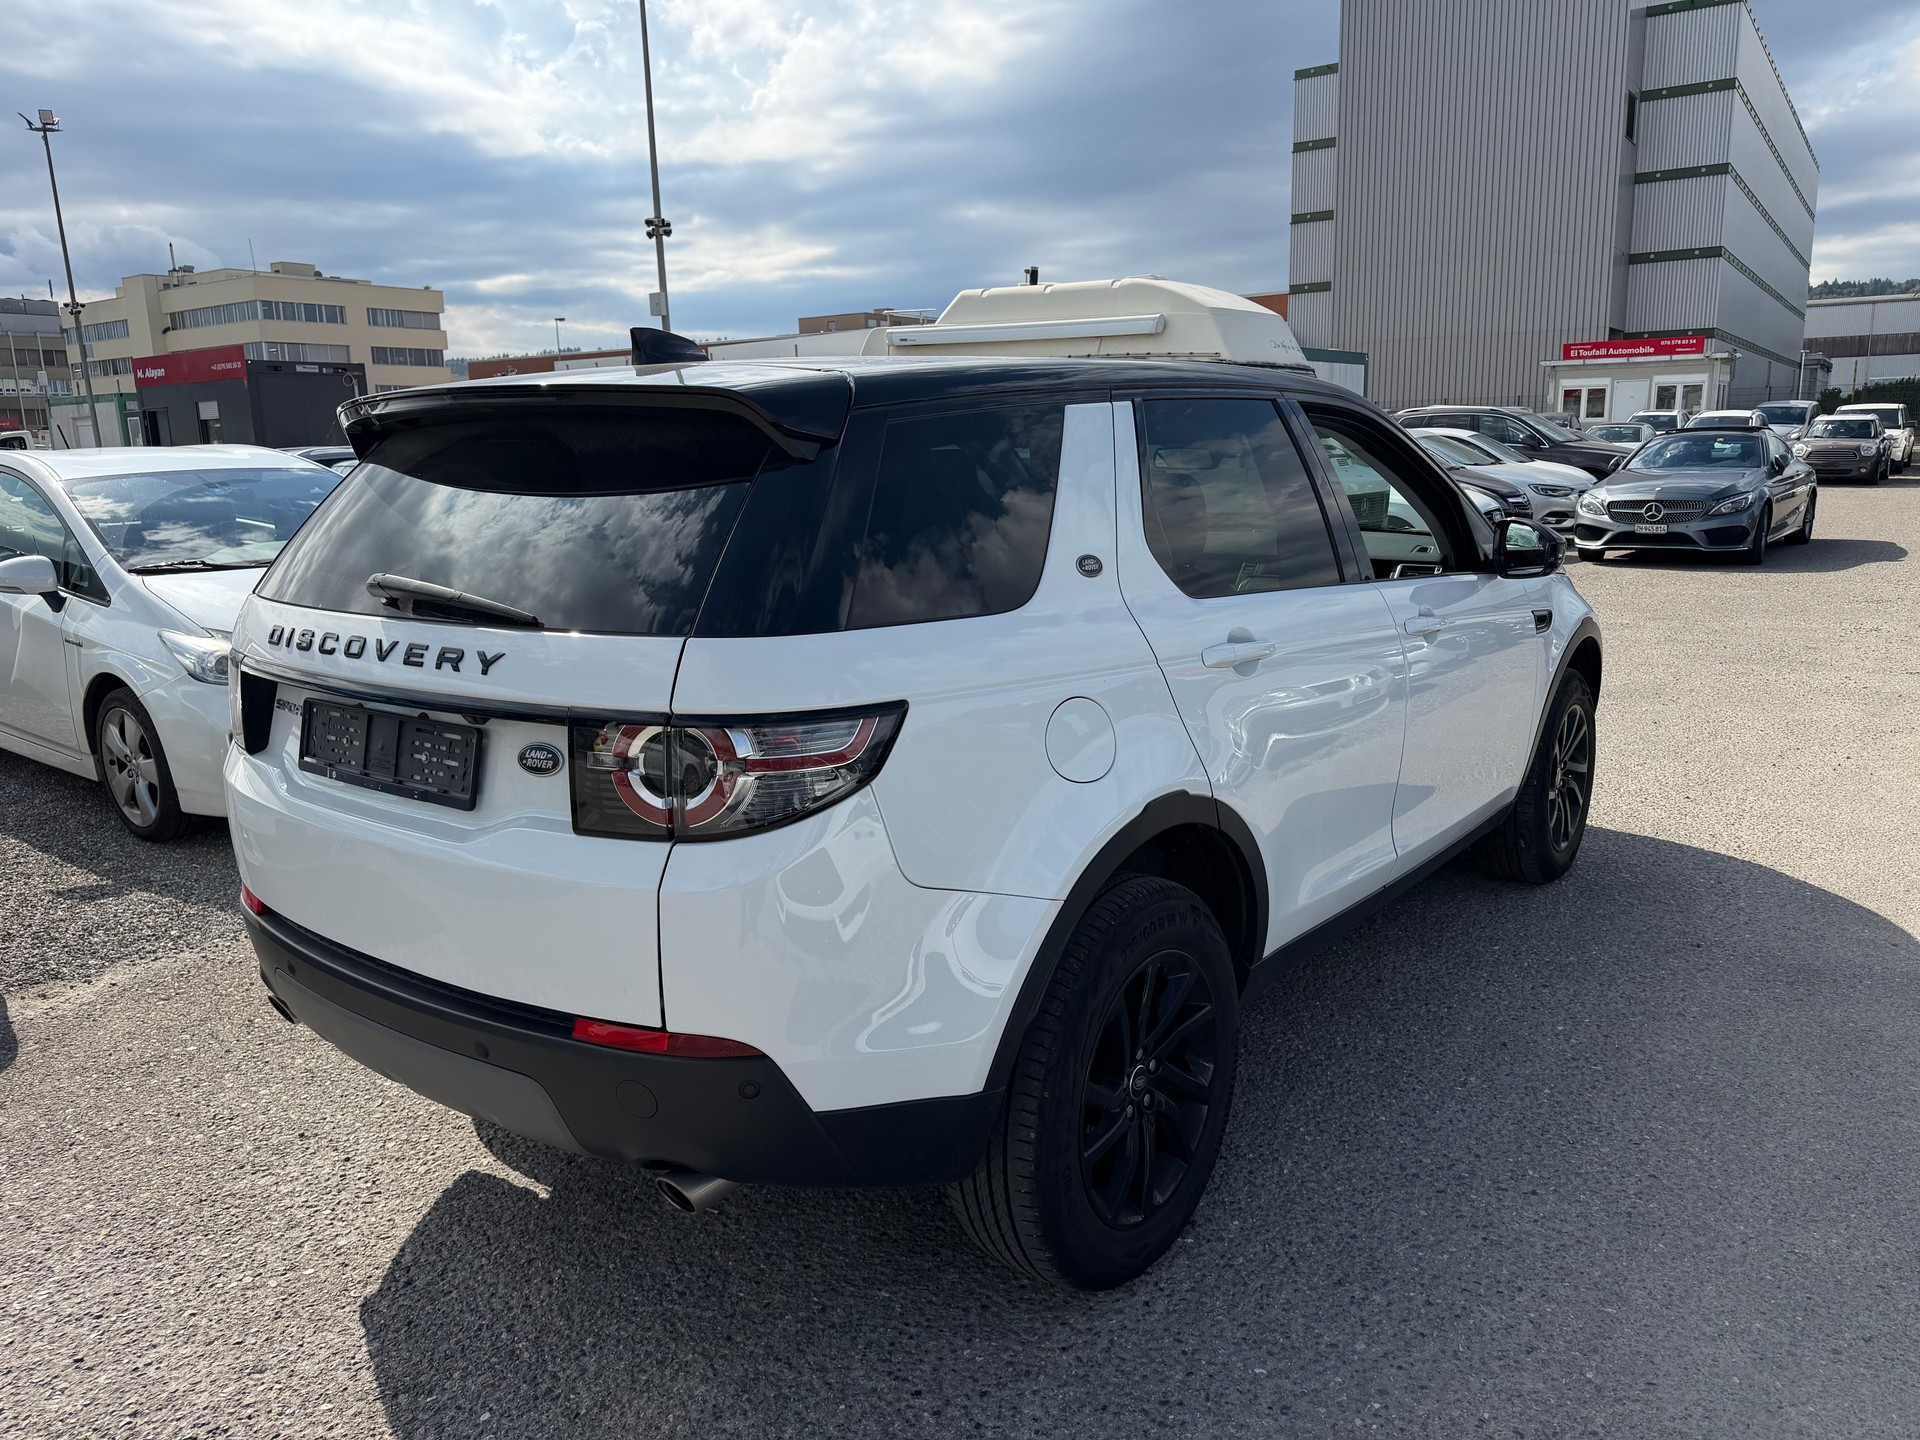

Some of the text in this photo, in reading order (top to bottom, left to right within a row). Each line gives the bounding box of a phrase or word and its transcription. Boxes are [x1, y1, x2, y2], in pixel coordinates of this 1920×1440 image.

[1578, 347, 1607, 356] Toufaili
[1608, 346, 1655, 355] Automobile
[137, 367, 166, 379] M. Alayan
[267, 624, 506, 676] DISCOVERY
[276, 699, 303, 716] SPOR
[525, 750, 547, 759] LAND
[526, 759, 554, 769] ROVER
